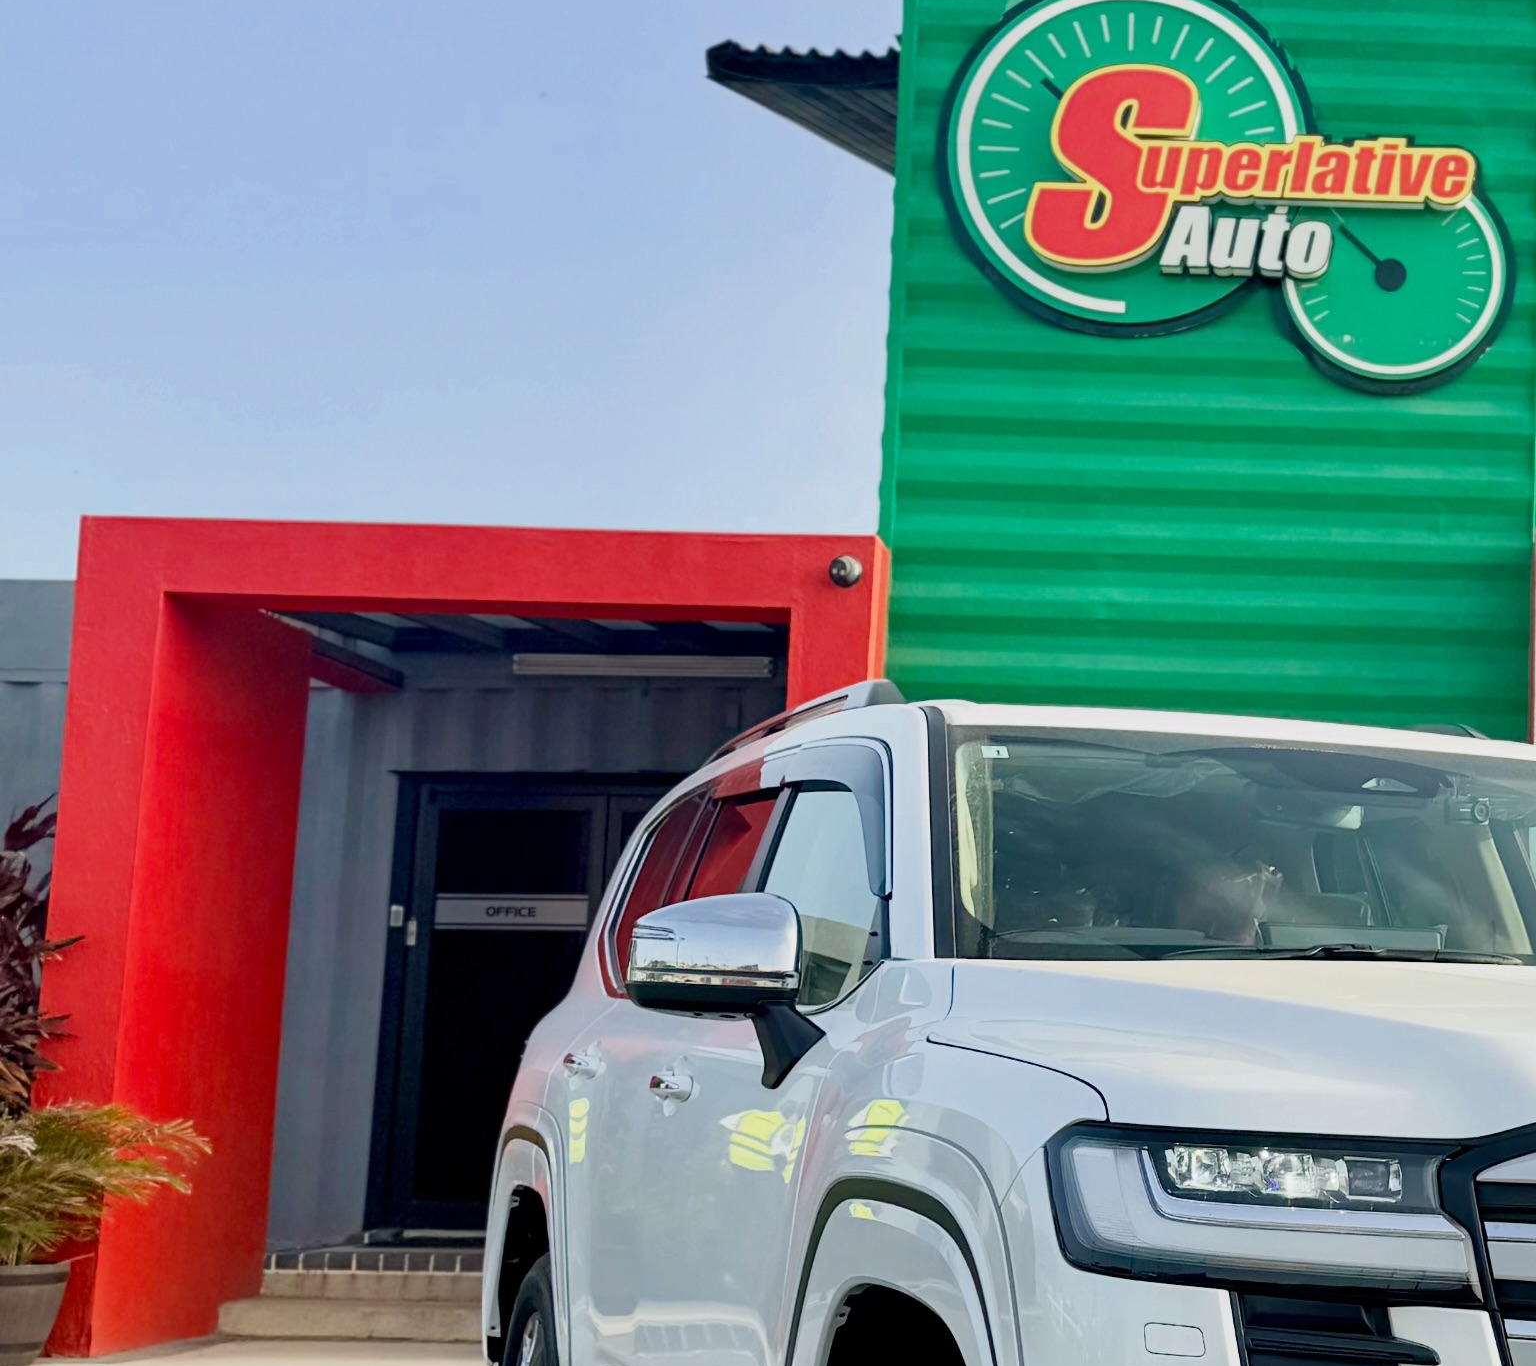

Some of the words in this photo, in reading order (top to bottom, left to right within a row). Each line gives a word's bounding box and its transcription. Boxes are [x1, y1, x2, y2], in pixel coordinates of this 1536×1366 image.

[1026, 65, 1474, 265] Superlative
[1159, 204, 1332, 278] Auto
[485, 906, 537, 918] OFFICE
